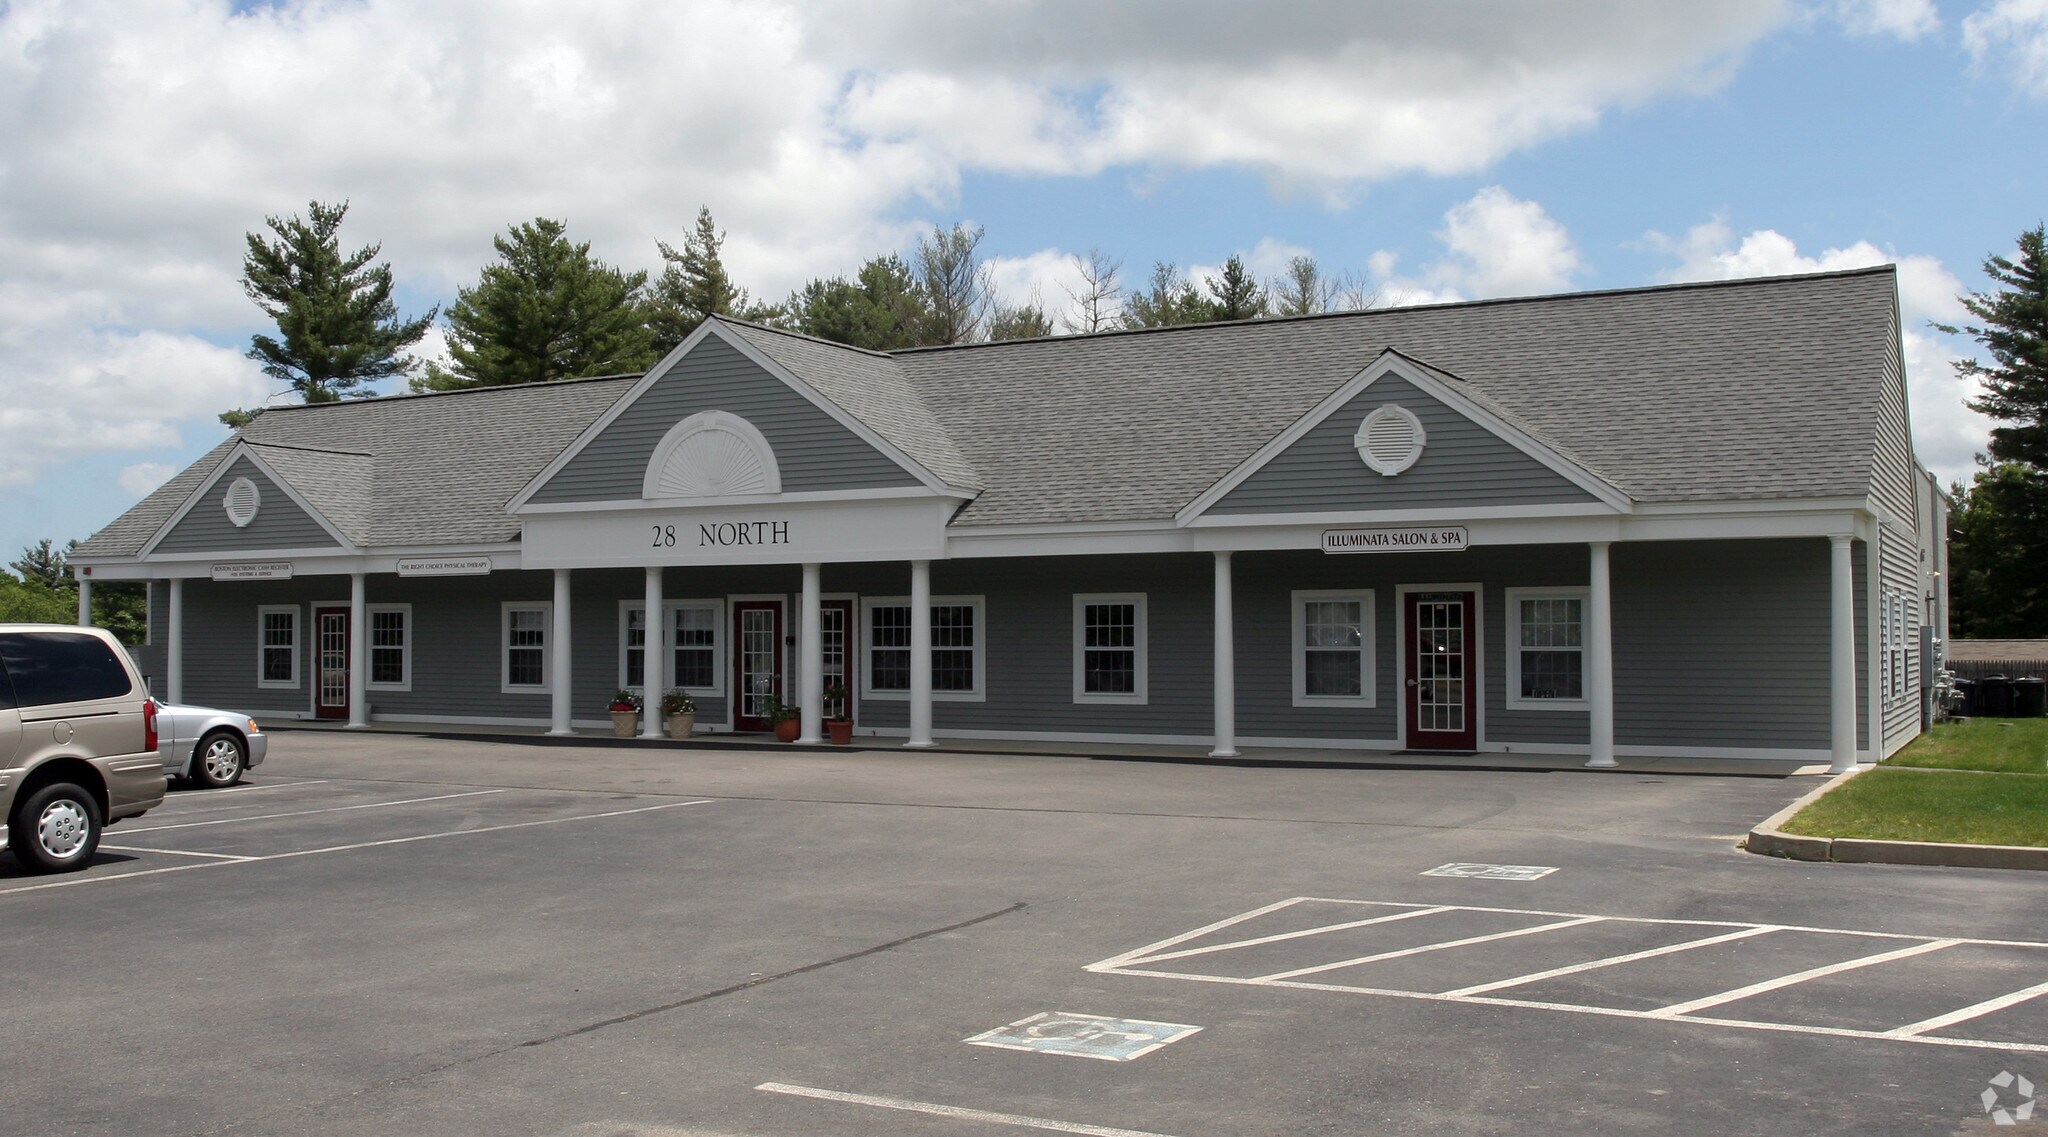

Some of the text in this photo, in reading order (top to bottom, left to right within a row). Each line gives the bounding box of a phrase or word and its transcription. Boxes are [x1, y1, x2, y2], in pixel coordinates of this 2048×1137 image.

[652, 521, 790, 547] 28 NORTH
[1328, 531, 1461, 547] ILLUMINATA SALON & SPA
